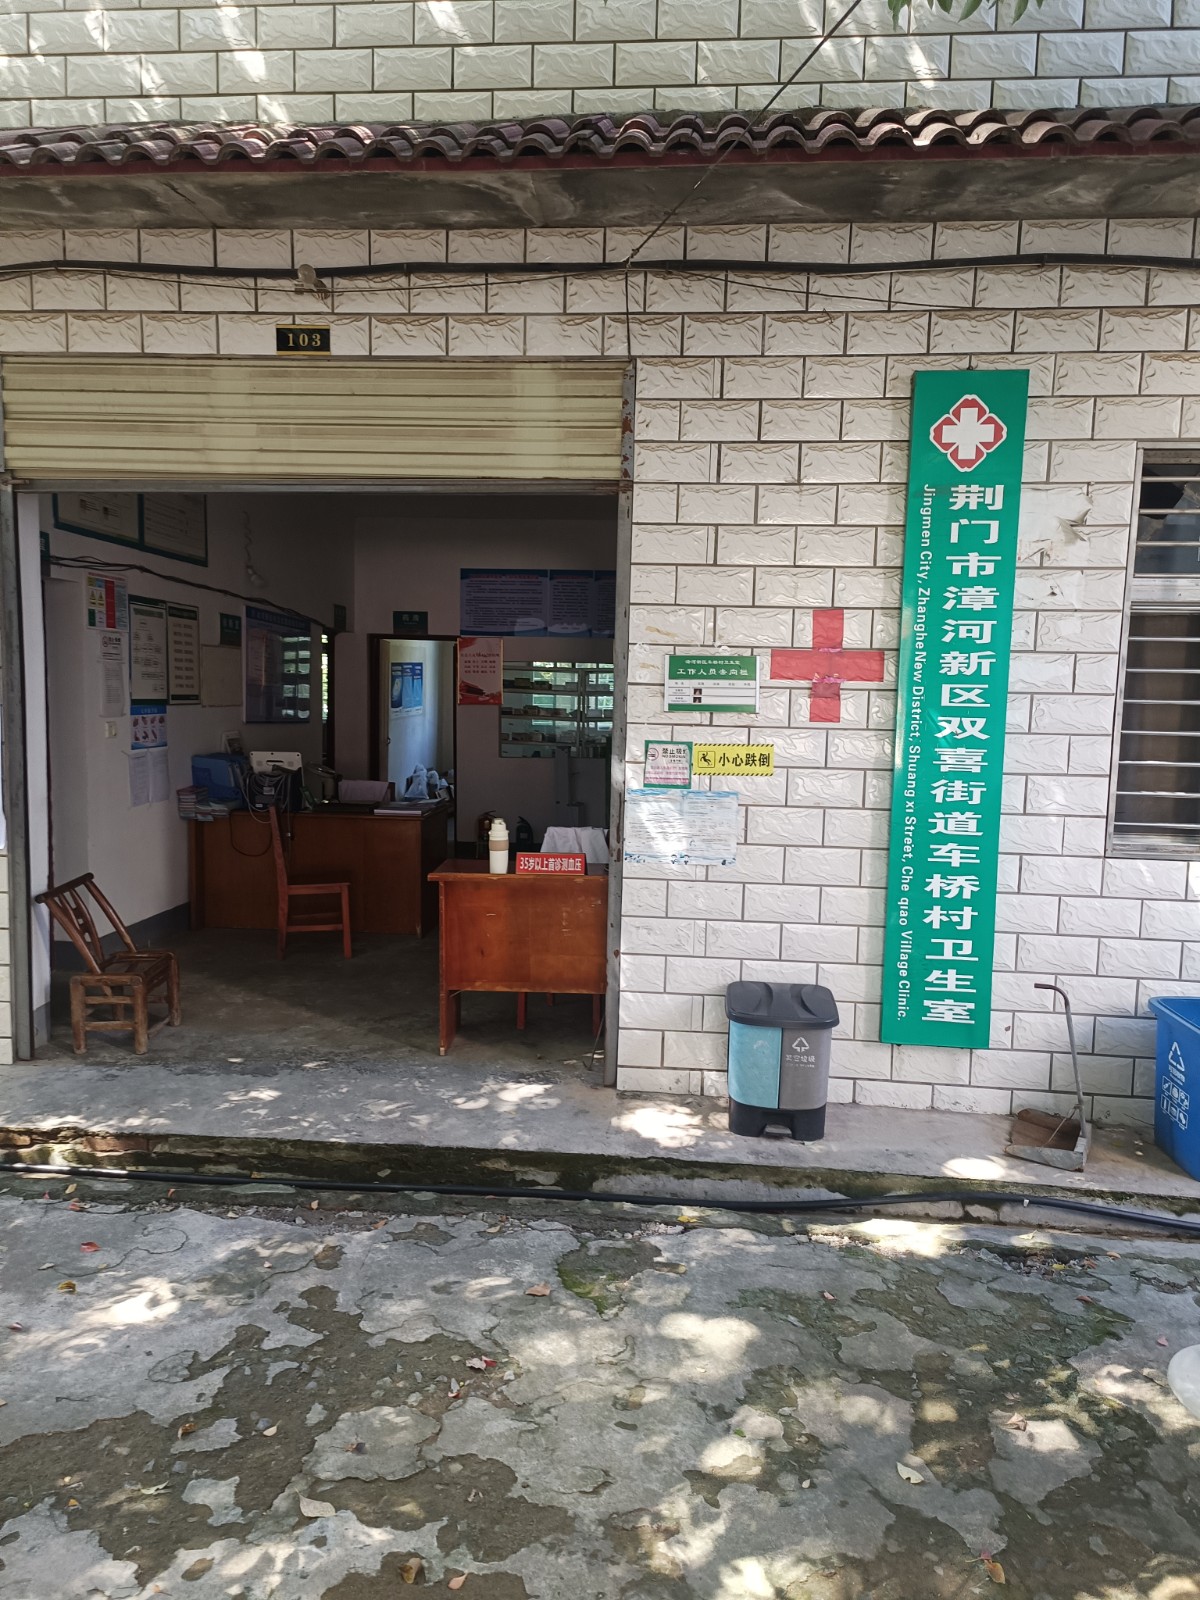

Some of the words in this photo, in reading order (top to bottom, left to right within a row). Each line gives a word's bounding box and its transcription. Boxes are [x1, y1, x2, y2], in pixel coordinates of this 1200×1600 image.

[287, 333, 321, 347] 103
[920, 484, 936, 547] Jingmen
[917, 550, 933, 584] City,
[913, 587, 930, 649] Zhanghe
[676, 668, 749, 676] 工作人员去向栏
[912, 651, 927, 682] New
[908, 686, 925, 742] District,
[718, 752, 771, 768] 小心跌倒
[904, 744, 921, 797] Shuang
[921, 484, 1004, 1024] 荆门市漳河新区双喜街道车桥村卫生室
[901, 815, 917, 863] Street,
[519, 857, 582, 871] 35岁以上首诊测血压
[901, 865, 914, 892] Che
[897, 930, 913, 977] Village
[896, 979, 911, 1022] Clinic.
